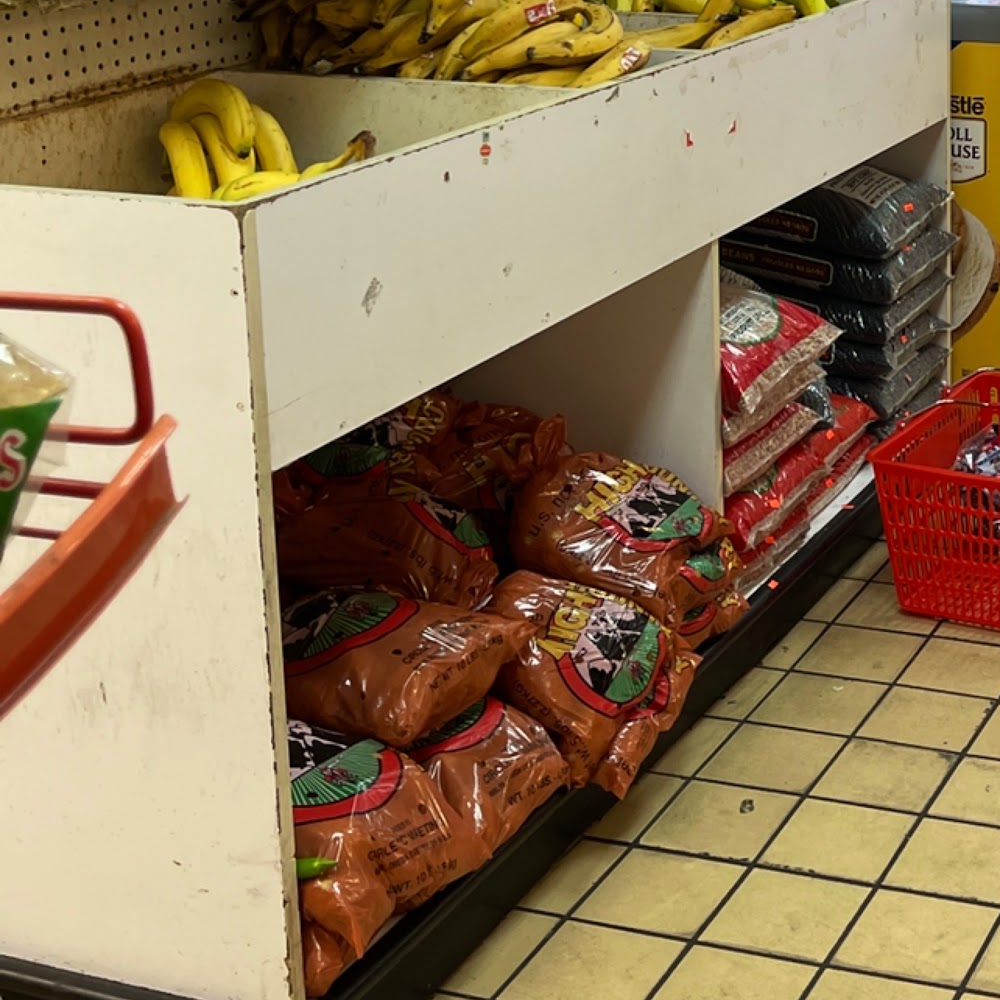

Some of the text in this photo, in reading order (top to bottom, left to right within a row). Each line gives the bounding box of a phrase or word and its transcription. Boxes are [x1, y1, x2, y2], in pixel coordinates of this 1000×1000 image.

[950, 127, 973, 142] LL
[951, 145, 981, 160] USE
[575, 459, 646, 522] HIGH
